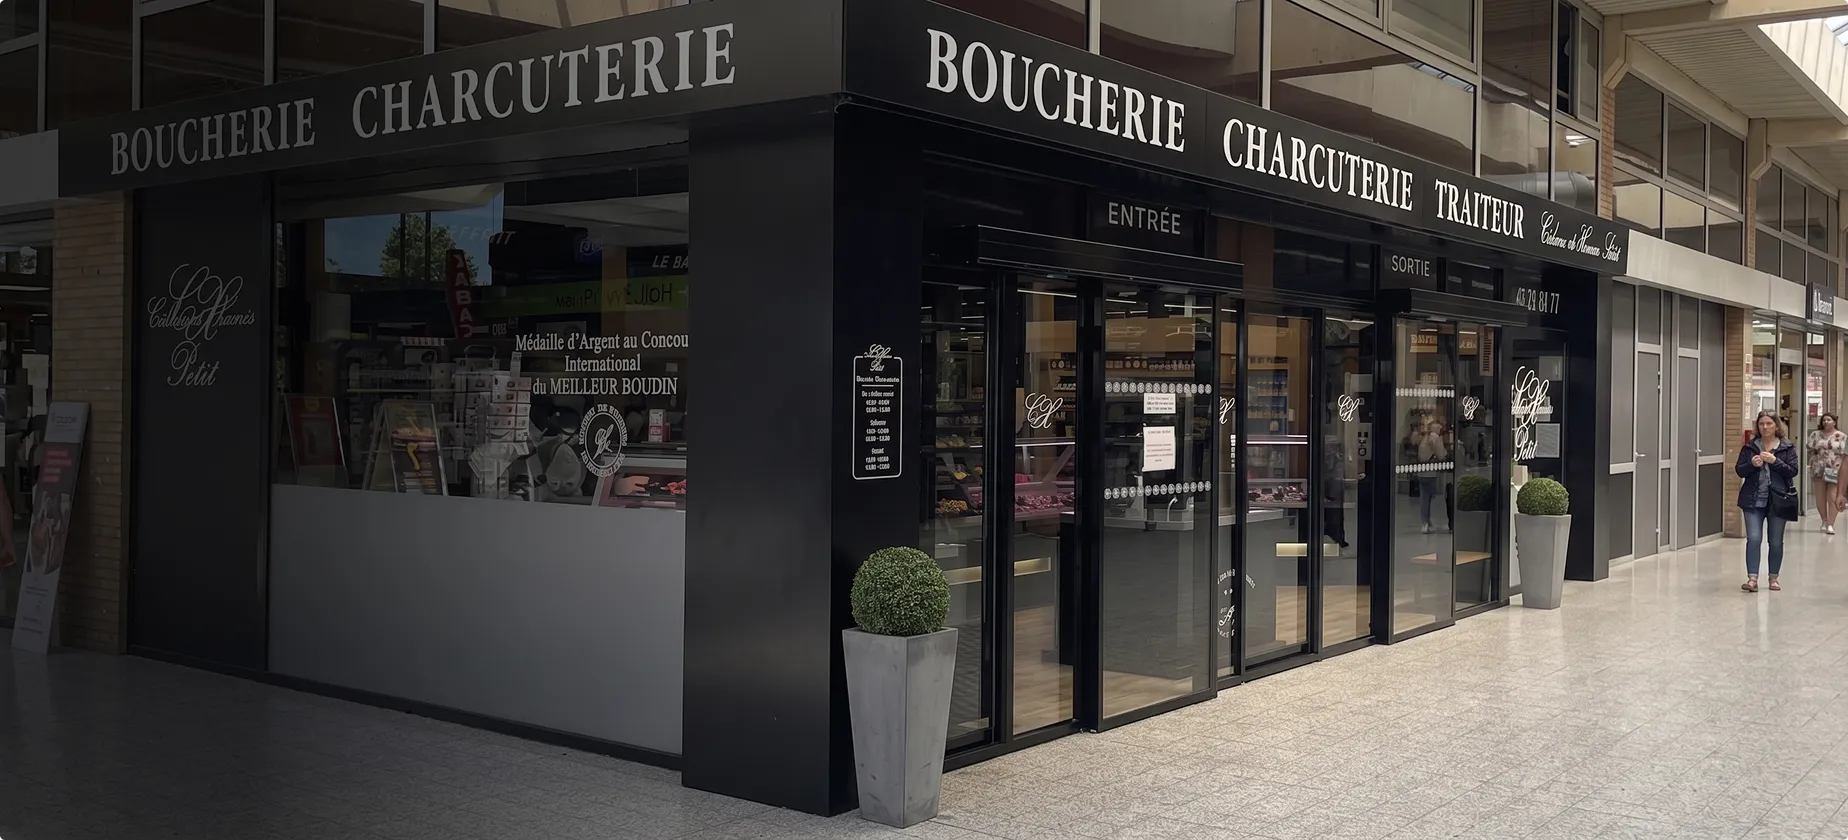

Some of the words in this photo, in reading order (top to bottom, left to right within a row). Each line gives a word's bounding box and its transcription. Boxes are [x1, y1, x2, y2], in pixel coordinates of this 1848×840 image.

[110, 97, 316, 175] BOUCHERIE
[352, 22, 736, 139] CHARCUTERIE
[926, 28, 1186, 153] BOUCHERIE
[1222, 118, 1414, 212] CHARCUTERIE
[1435, 179, 1525, 239] TRAITEUR
[1108, 201, 1181, 235] ENTRÉE
[1391, 254, 1431, 277] SORTIE
[1550, 293, 1560, 314] 77
[515, 332, 565, 351] Médaille
[623, 335, 638, 349] au
[167, 340, 220, 386] Petit
[564, 353, 641, 372] International
[532, 377, 547, 395] du
[549, 377, 619, 395] MEILLEUR
[621, 377, 678, 395] BOUDIN
[1514, 424, 1538, 461] Petit
